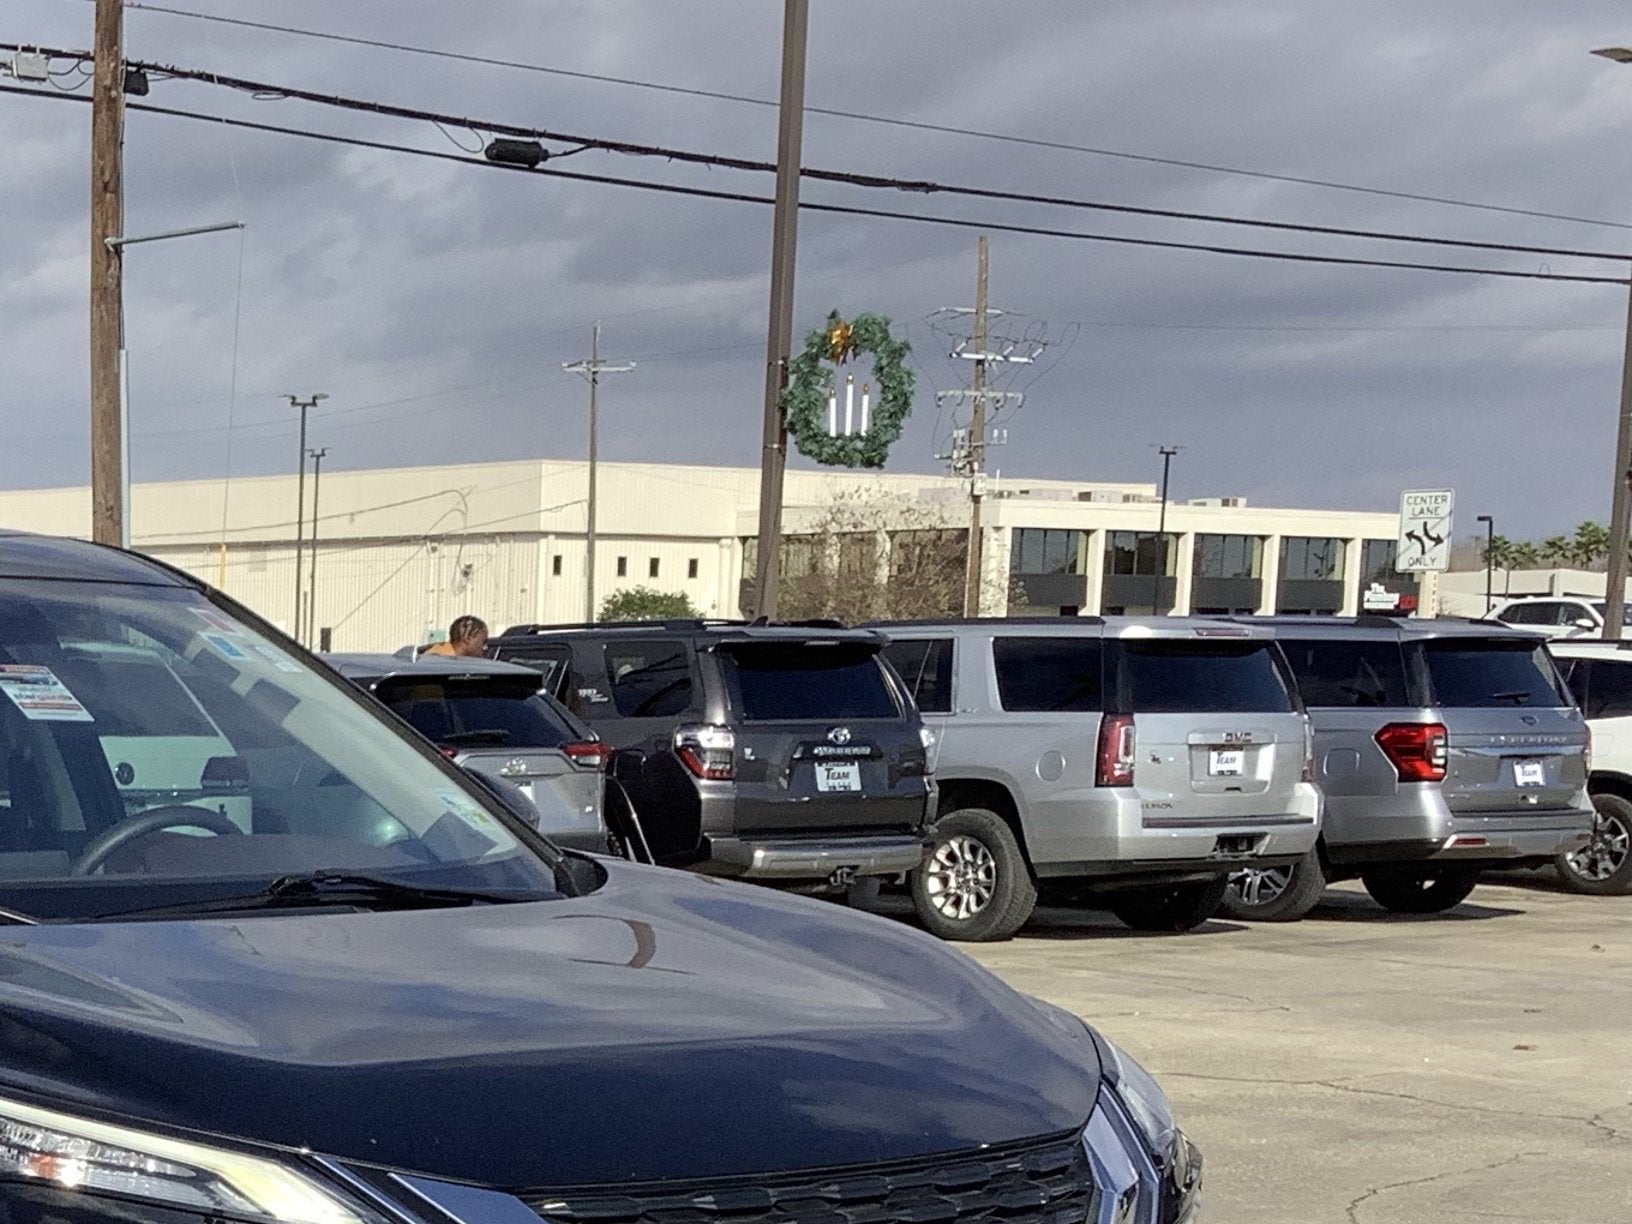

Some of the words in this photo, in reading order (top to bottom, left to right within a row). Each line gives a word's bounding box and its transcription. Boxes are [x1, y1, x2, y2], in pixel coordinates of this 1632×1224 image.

[1406, 494, 1449, 506] CENTER
[1411, 506, 1441, 517] LANE
[1407, 556, 1437, 567] ONLY
[824, 767, 851, 781] TEAM
